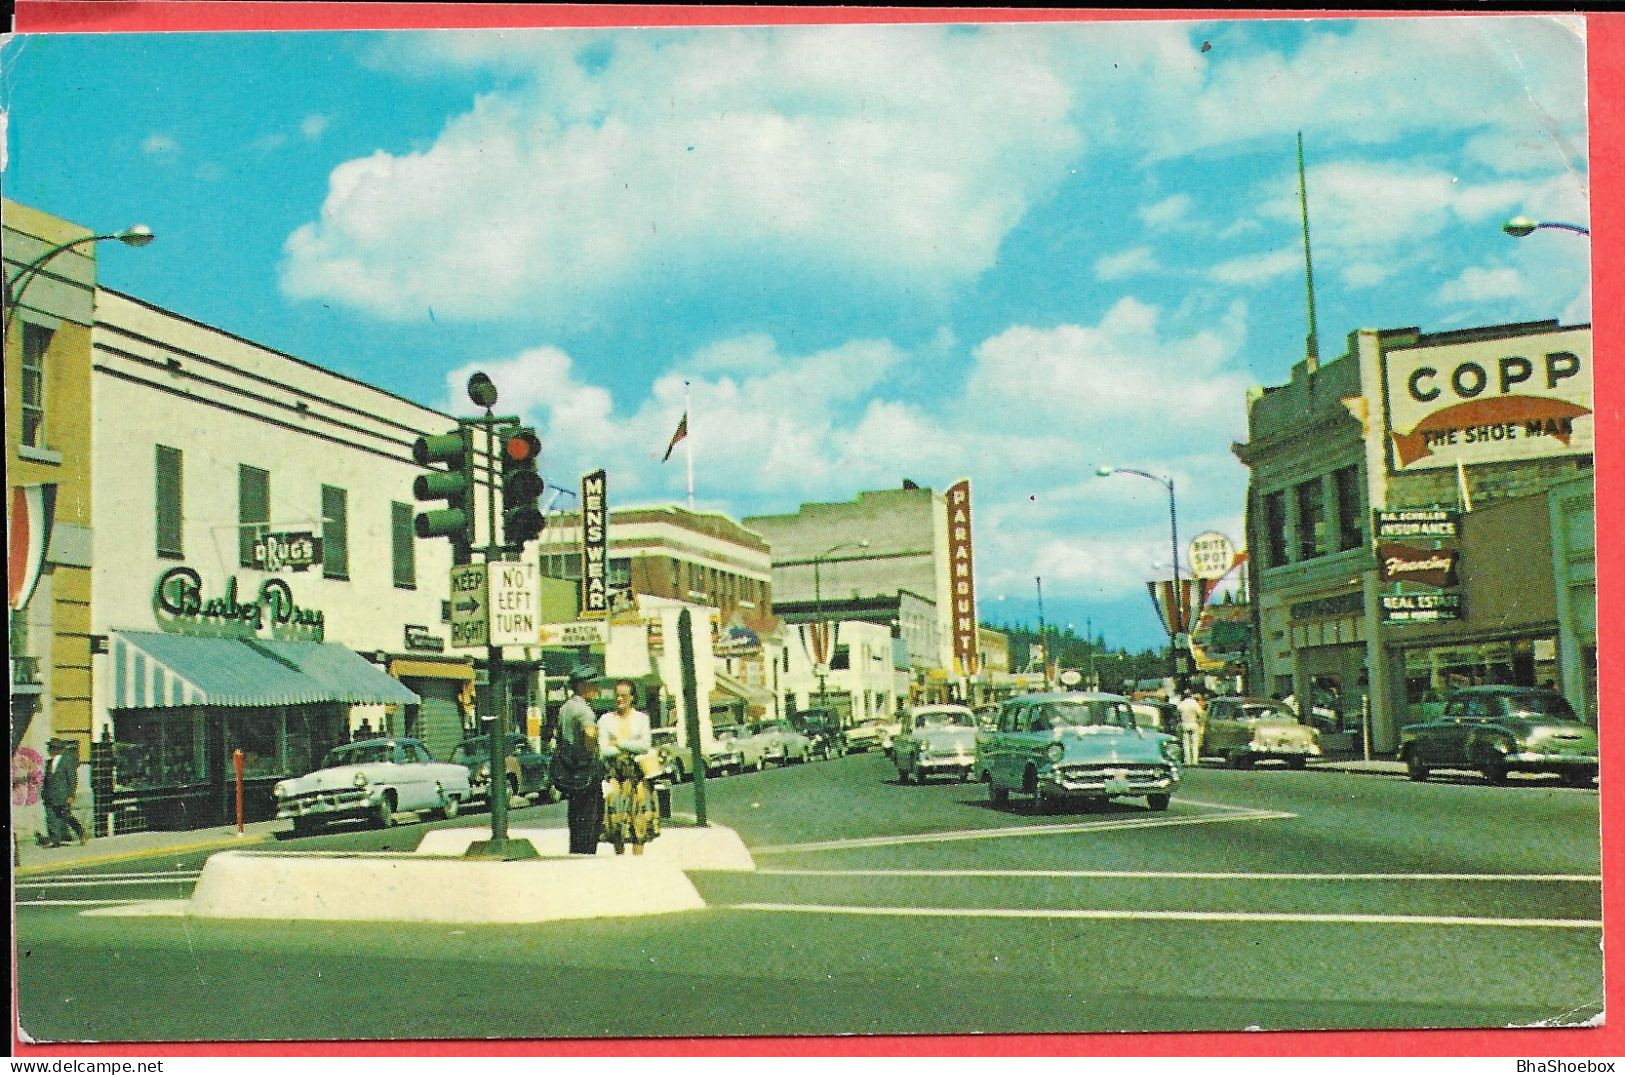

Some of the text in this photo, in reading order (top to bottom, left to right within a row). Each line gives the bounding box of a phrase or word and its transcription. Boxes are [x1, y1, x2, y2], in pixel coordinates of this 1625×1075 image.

[1408, 351, 1581, 402] COPP
[1424, 416, 1573, 446] THE SHOE MAN
[1380, 522, 1455, 535] INSURANCE
[1195, 552, 1227, 565] SPOT
[503, 570, 525, 588] NO
[588, 545, 604, 611] WEAR
[953, 489, 971, 649] PARAMOUNT
[452, 570, 483, 592] KEEP
[258, 577, 326, 644] Drug
[498, 592, 531, 610] LEFT
[1383, 596, 1458, 608] REAL ESTATE
[452, 620, 485, 643] RIGHT
[497, 614, 533, 633] TURN
[564, 625, 598, 634] WATCH
